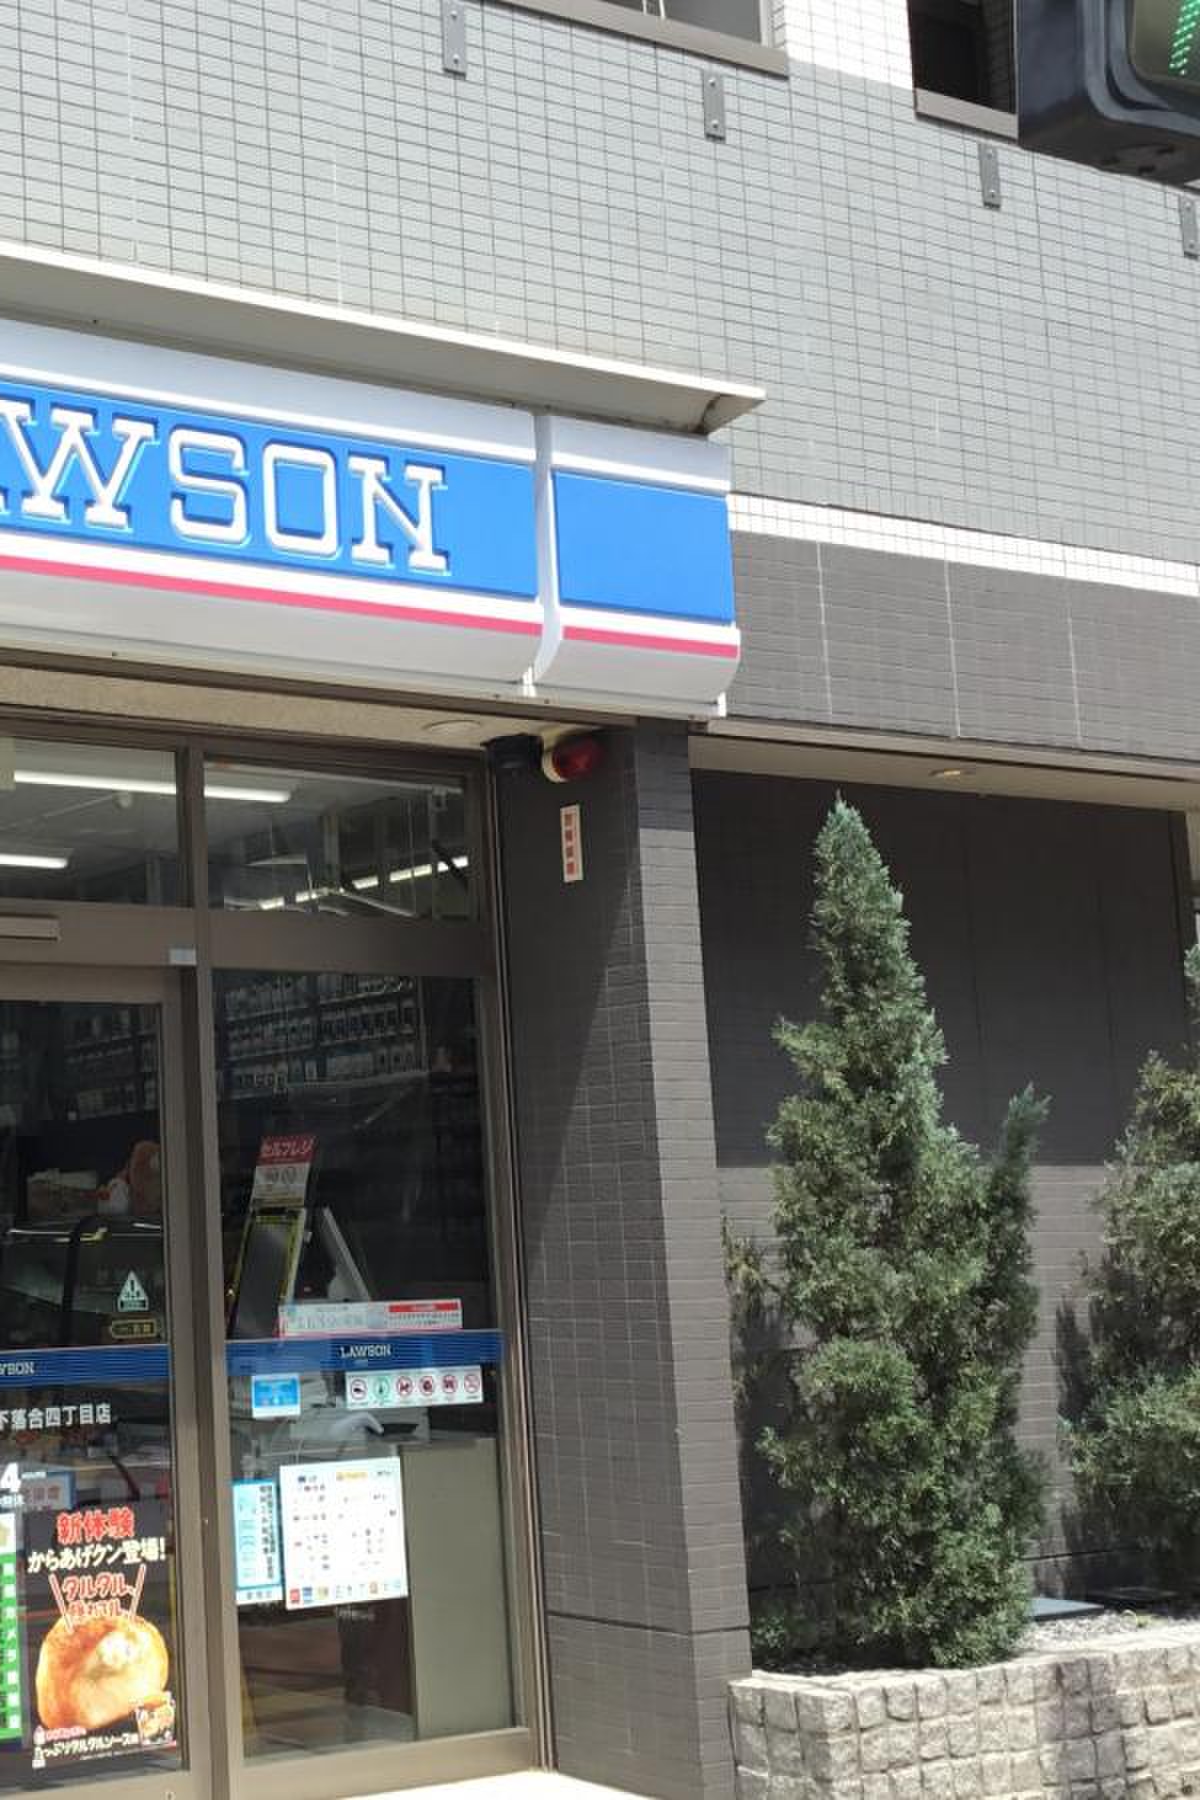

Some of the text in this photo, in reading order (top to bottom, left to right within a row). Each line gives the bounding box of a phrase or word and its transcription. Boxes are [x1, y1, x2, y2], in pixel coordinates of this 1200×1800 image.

[339, 1343, 392, 1359] LAWSON
[56, 1507, 135, 1544] 新体験
